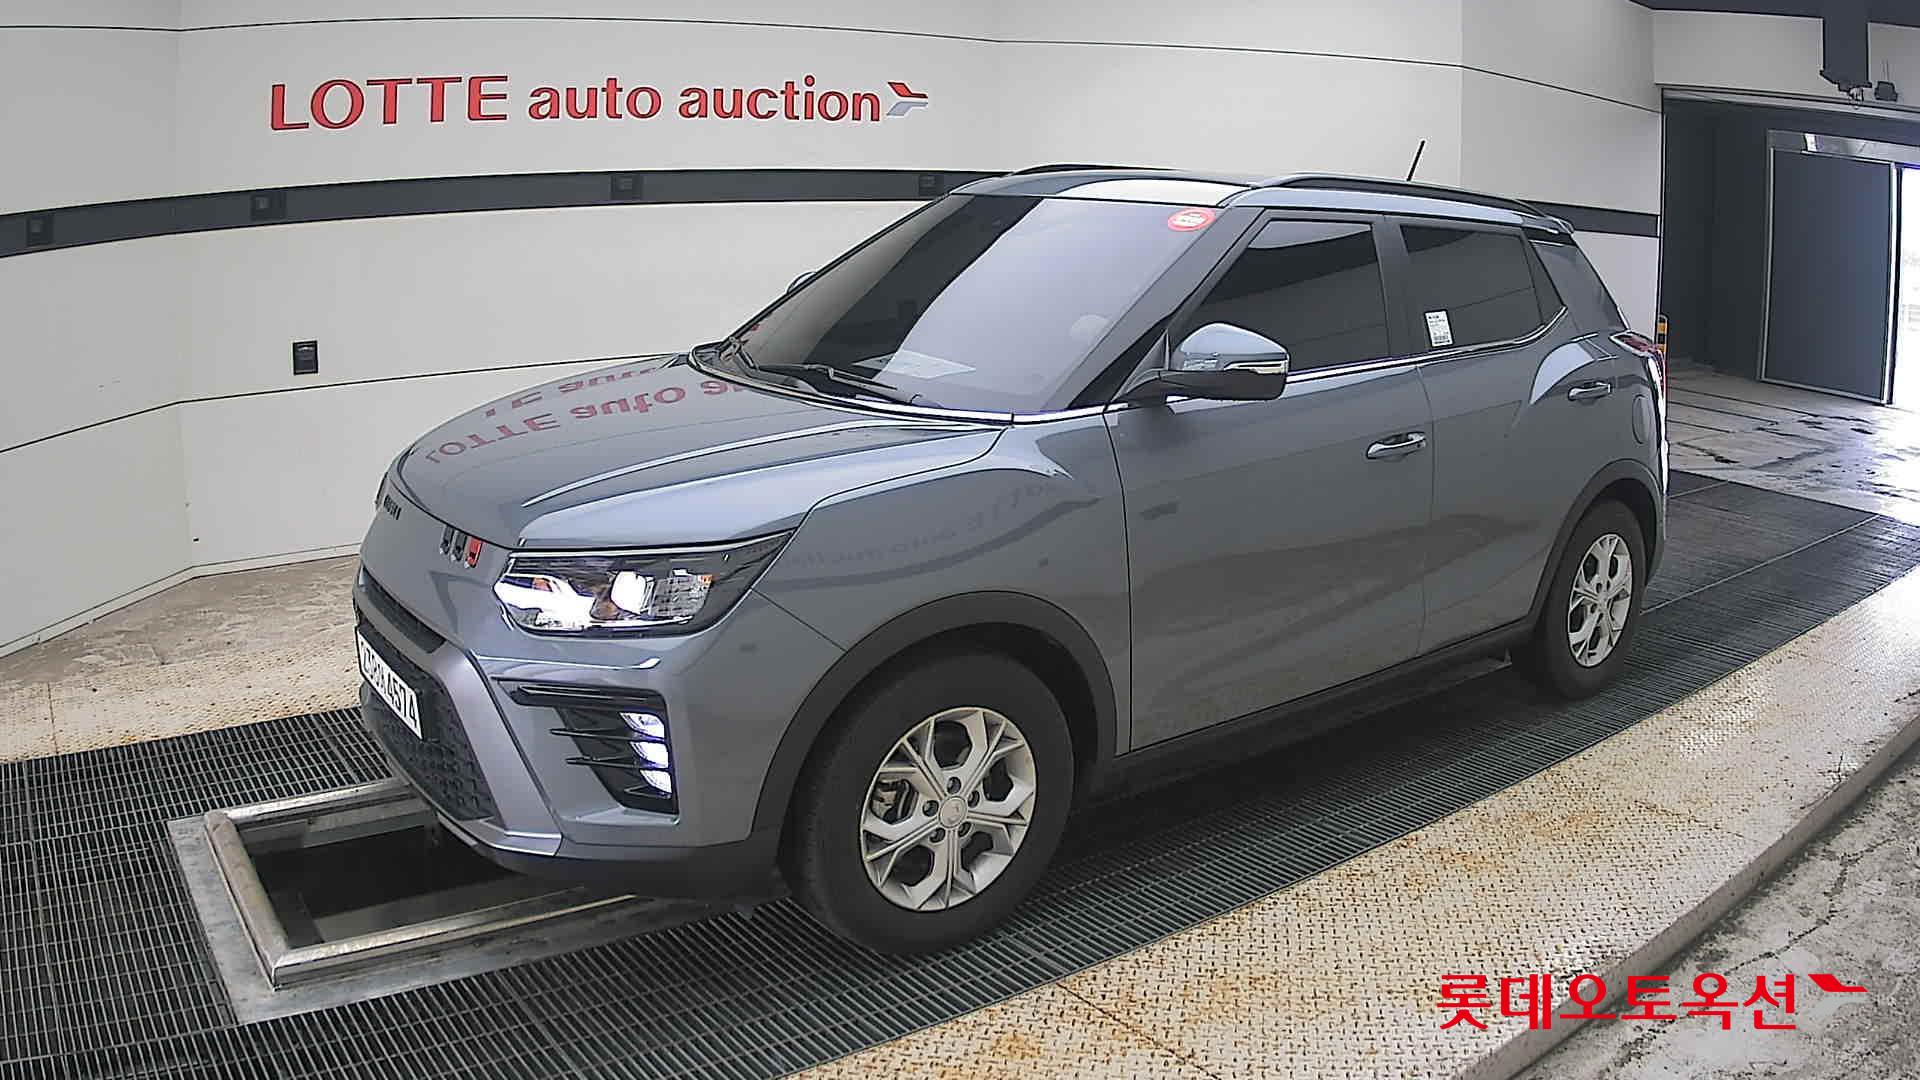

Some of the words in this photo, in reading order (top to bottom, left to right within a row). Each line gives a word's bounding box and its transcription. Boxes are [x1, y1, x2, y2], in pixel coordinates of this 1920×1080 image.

[270, 75, 507, 131] LOTTE
[527, 77, 661, 120] auto
[678, 75, 881, 122] auction
